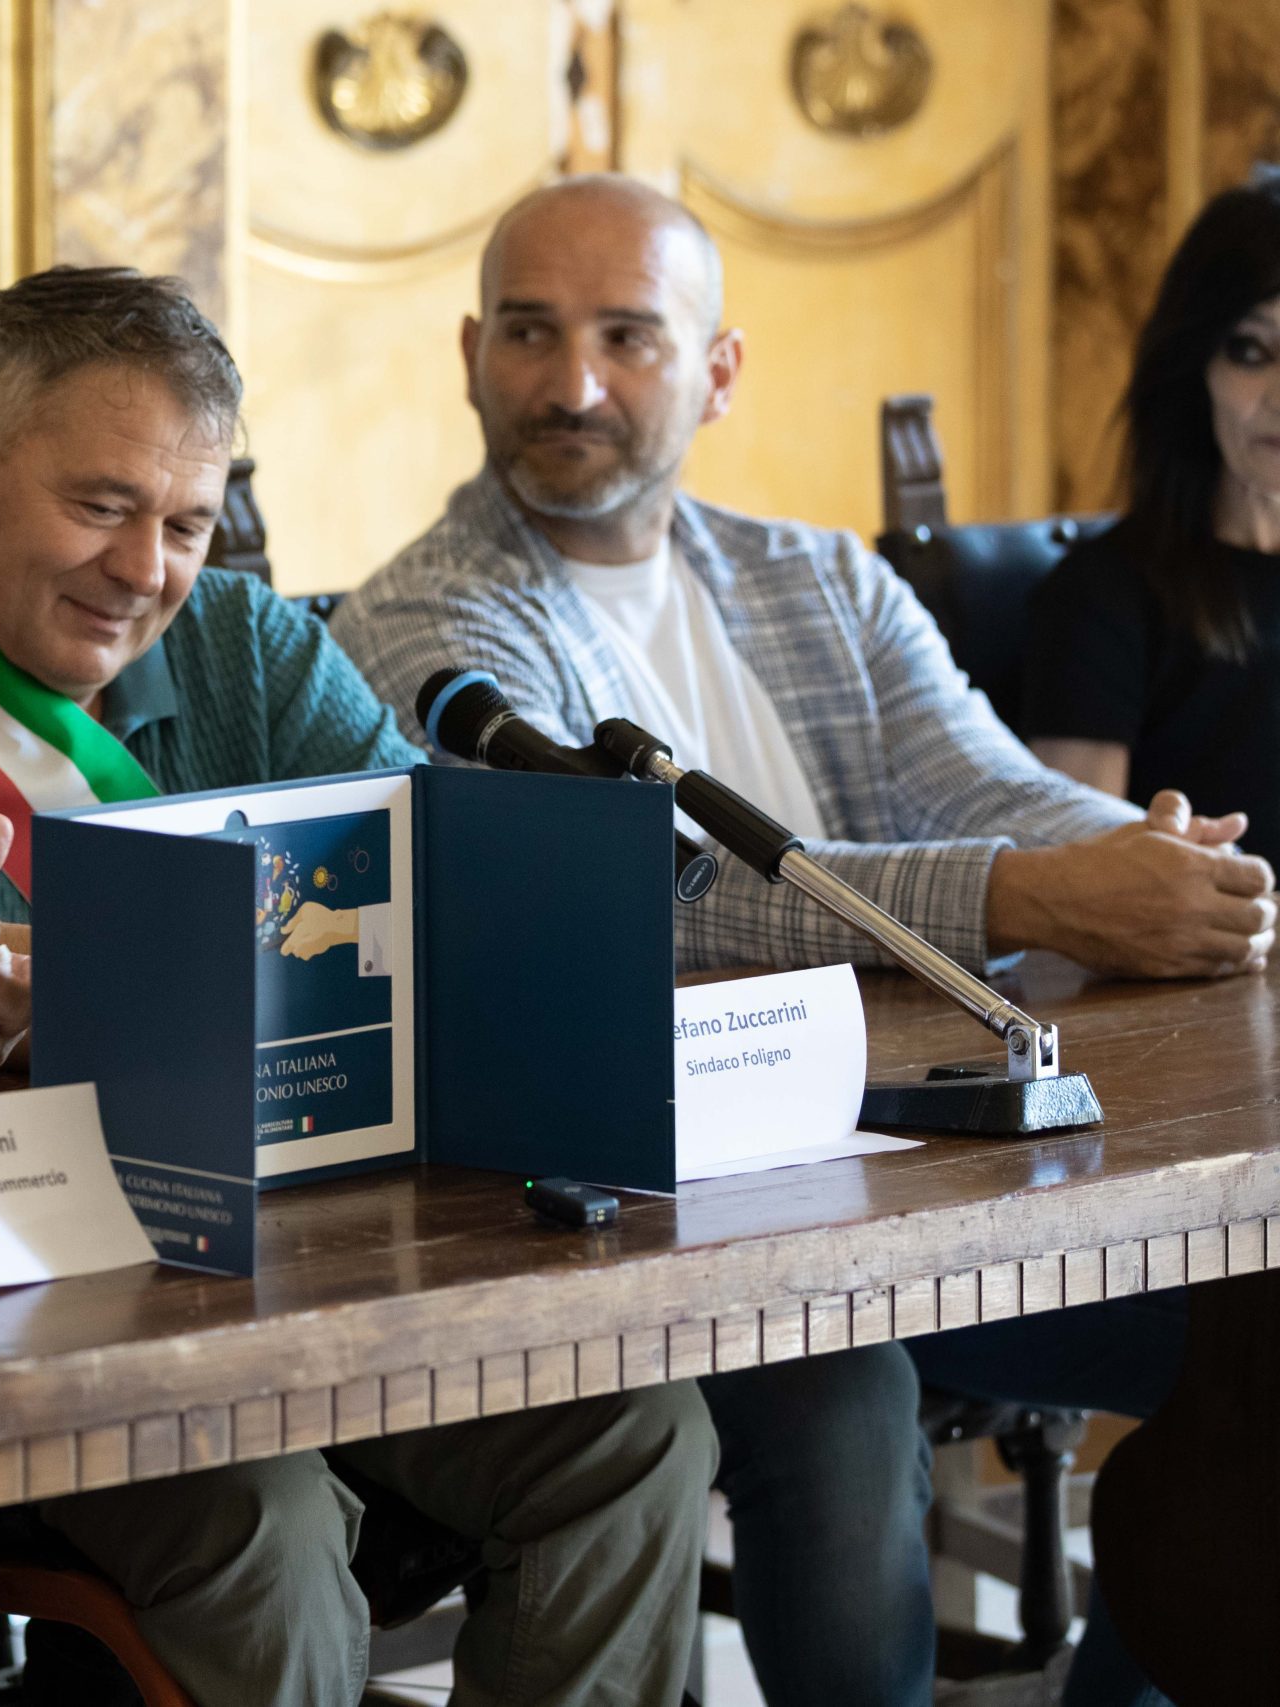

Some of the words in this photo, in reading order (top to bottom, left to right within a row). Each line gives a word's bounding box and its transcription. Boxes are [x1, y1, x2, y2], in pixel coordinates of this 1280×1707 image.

[725, 999, 808, 1032] Zuccarini
[276, 1052, 337, 1077] ITALIANA
[686, 1056, 740, 1076] Sindaco
[742, 1047, 791, 1067] Foligno
[296, 1073, 348, 1097] UNESCO
